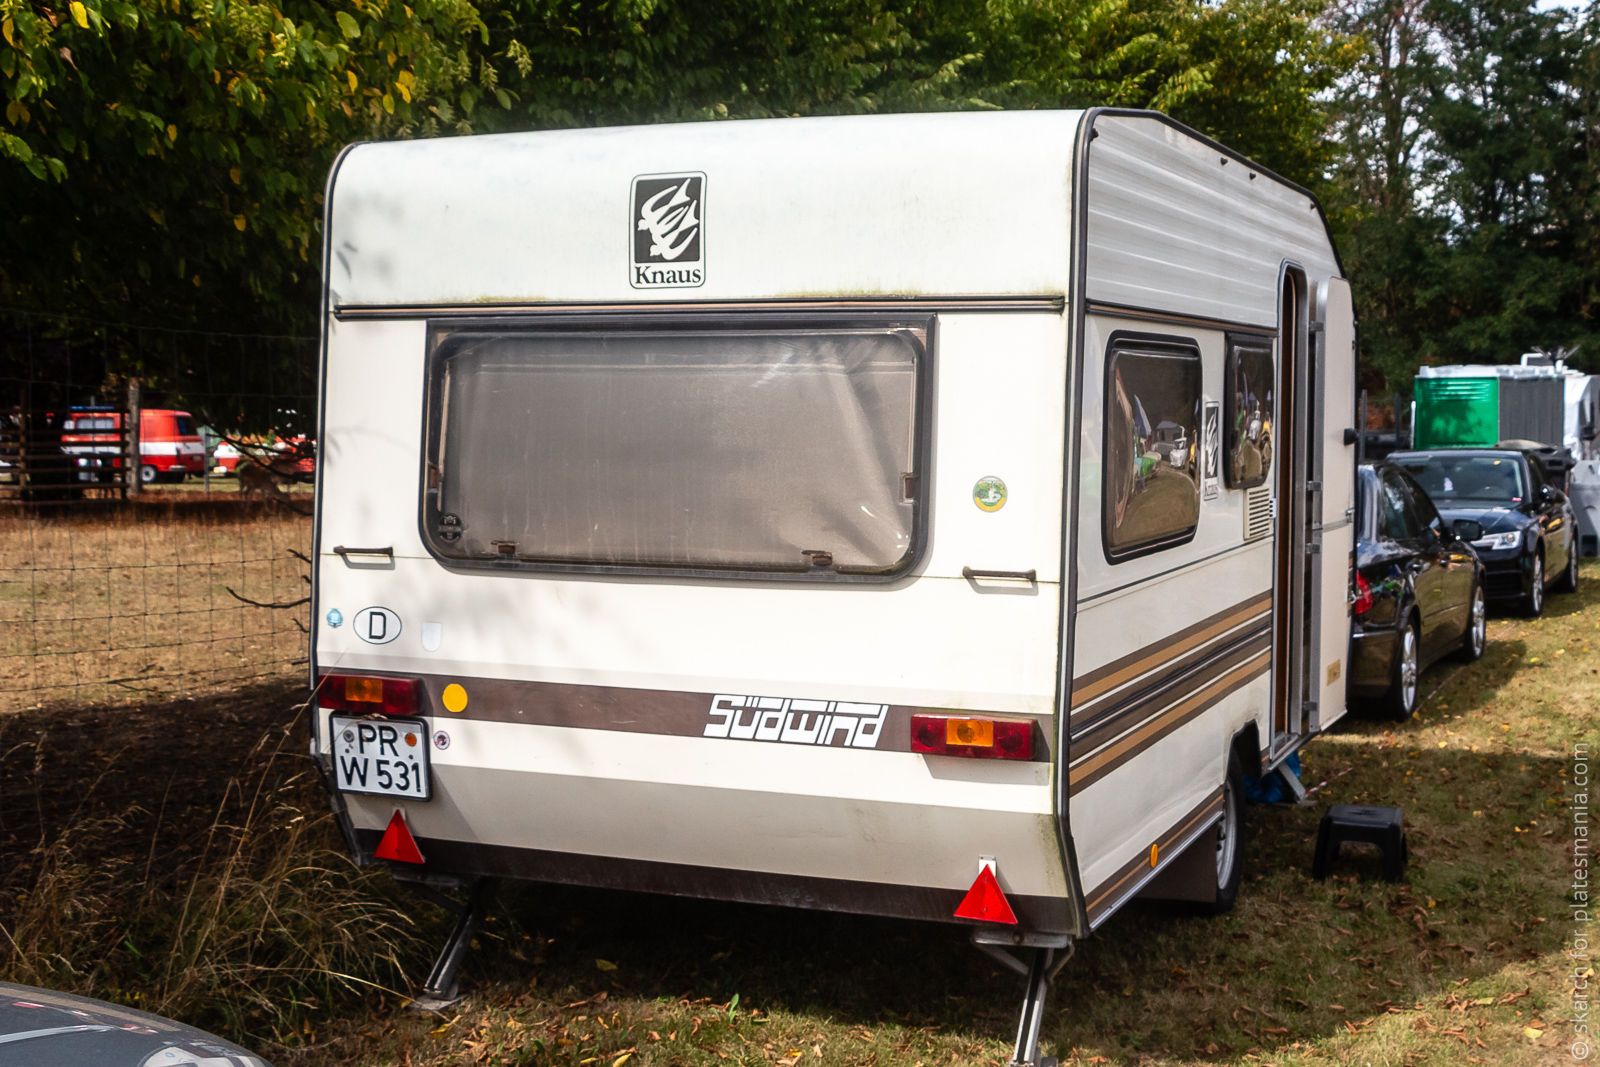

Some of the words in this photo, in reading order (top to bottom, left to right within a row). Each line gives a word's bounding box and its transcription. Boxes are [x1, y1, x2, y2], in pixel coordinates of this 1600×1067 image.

[635, 265, 701, 285] Knaus
[368, 611, 387, 640] D
[357, 724, 400, 757] PR
[340, 756, 369, 788] W
[376, 758, 422, 793] 531
